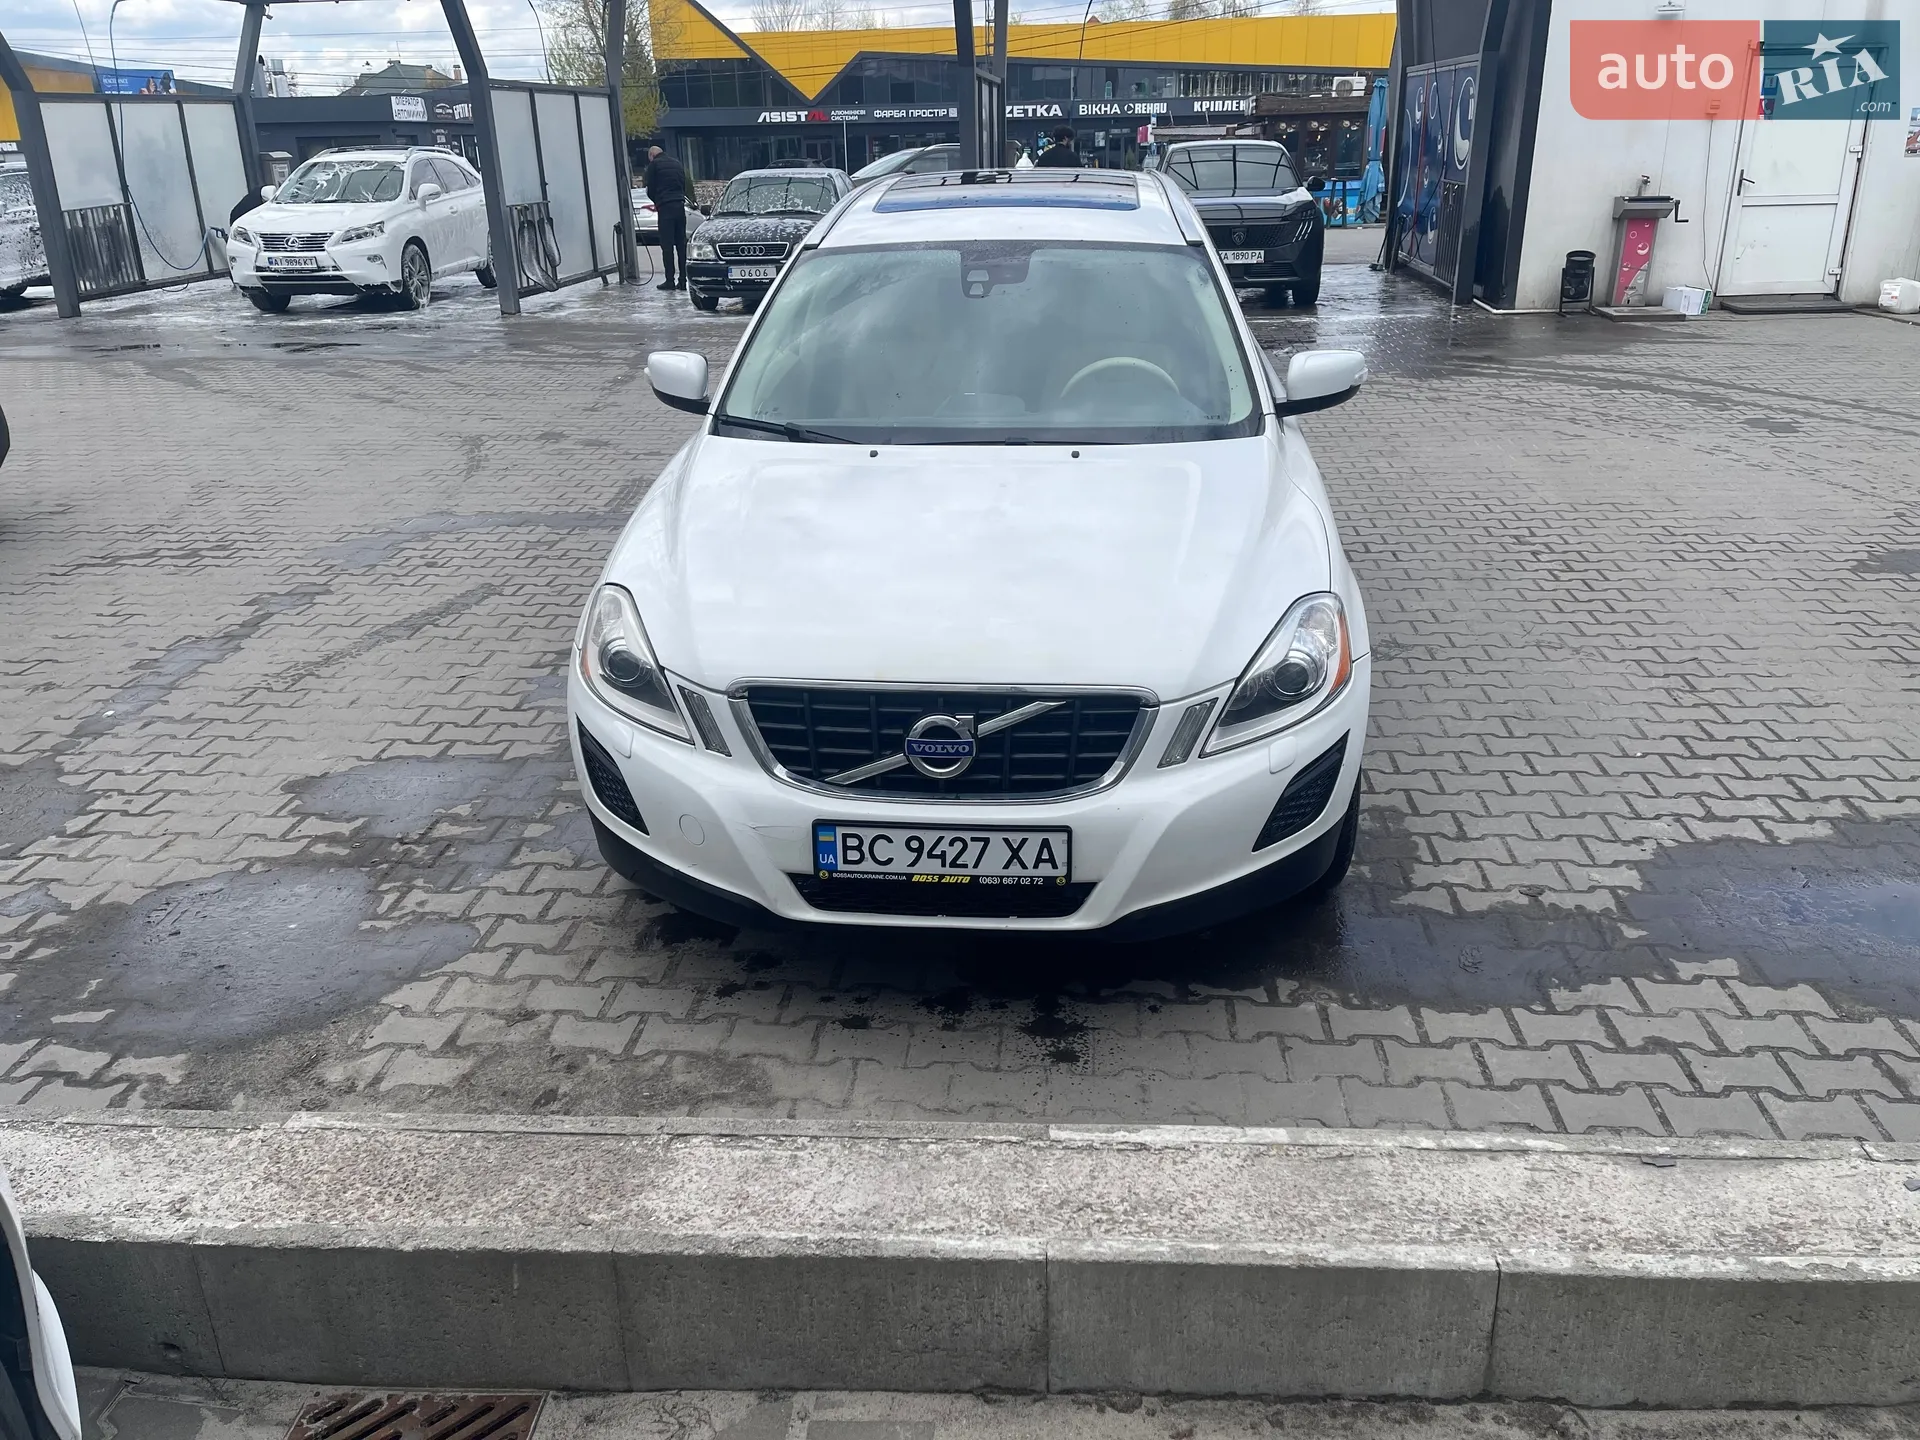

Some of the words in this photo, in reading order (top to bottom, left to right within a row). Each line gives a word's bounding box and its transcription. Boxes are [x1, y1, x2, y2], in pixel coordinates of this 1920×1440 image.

[873, 109, 906, 118] ФАРБА
[908, 108, 948, 118] ПРОСТІР
[1005, 104, 1063, 118] ZETKA
[1079, 103, 1121, 115] ВІКНА
[1135, 102, 1168, 114] REHAU
[1231, 252, 1249, 260] 1890
[285, 258, 302, 266] 9896
[911, 743, 970, 753] VOLVO
[841, 832, 895, 867] BC
[904, 835, 991, 869] 9427
[1001, 837, 1059, 870] XA
[819, 854, 836, 864] UA
[832, 872, 907, 881] BOSSAUTOUKRAINE.COM.UA
[911, 874, 940, 883] BOSS
[940, 875, 971, 884] AUTO
[979, 876, 1001, 885] (063)
[1002, 876, 1019, 885] 667
[1020, 876, 1031, 885] 02
[1032, 877, 1044, 885] 72
